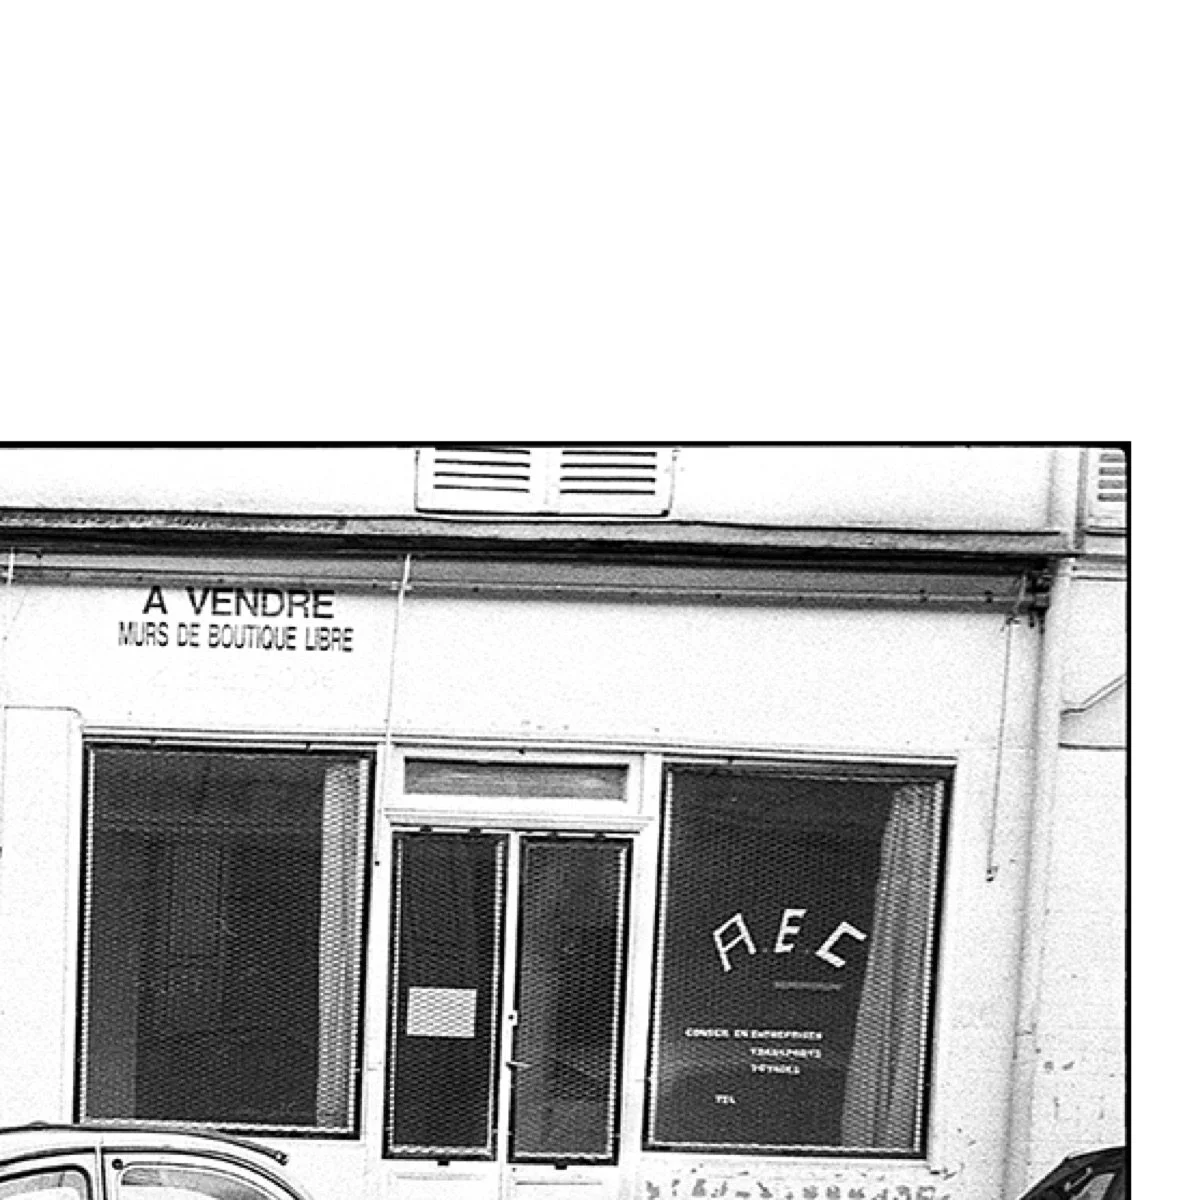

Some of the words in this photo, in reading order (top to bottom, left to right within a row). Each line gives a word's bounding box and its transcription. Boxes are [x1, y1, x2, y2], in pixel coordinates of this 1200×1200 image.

[142, 586, 168, 614] A
[186, 587, 335, 618] VENDRE
[118, 622, 169, 646] MURS
[177, 622, 201, 647] DE
[208, 624, 297, 651] BOUTIQUE
[305, 627, 354, 652] LIBRE
